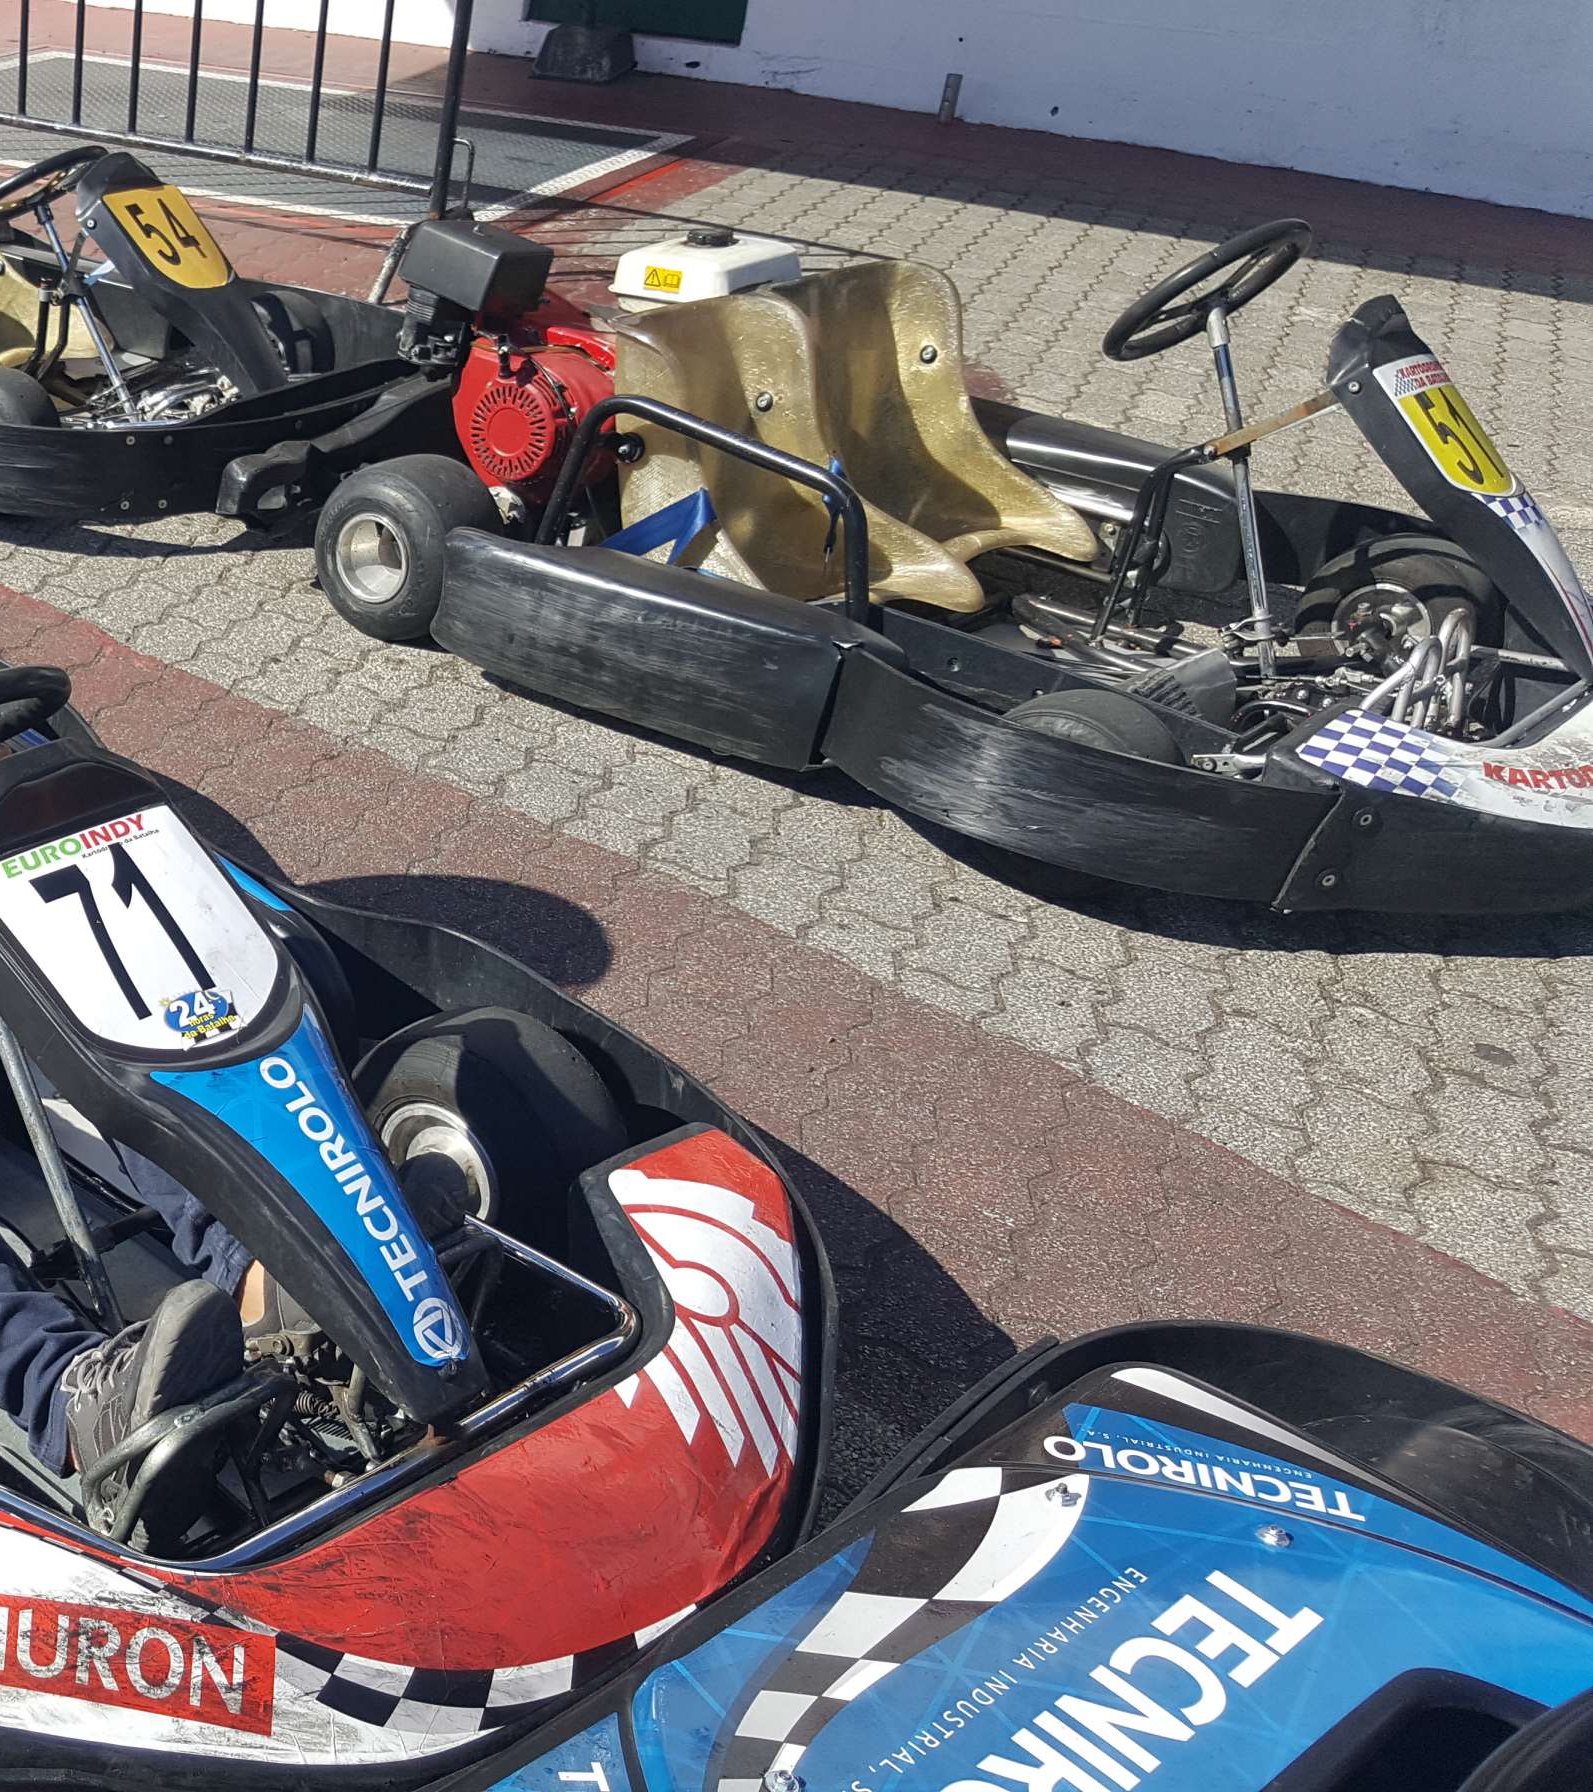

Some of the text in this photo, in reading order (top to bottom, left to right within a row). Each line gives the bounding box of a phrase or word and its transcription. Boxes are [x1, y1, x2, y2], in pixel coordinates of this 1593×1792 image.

[124, 198, 207, 265] 54
[1414, 387, 1505, 485] 51
[1, 813, 146, 879] EUROINDY
[133, 829, 161, 841] Batalha
[28, 843, 216, 1021] 71
[169, 991, 216, 1028] 24
[197, 1013, 238, 1034] Batalha
[259, 1056, 428, 1302] TECNIROLO
[1042, 1435, 1367, 1523] TECNIROLO
[1215, 1455, 1313, 1480] ENGENHARIA
[1011, 1566, 1149, 1671] ENGENHARIA
[867, 1668, 1019, 1775] INDUSTRIAL,
